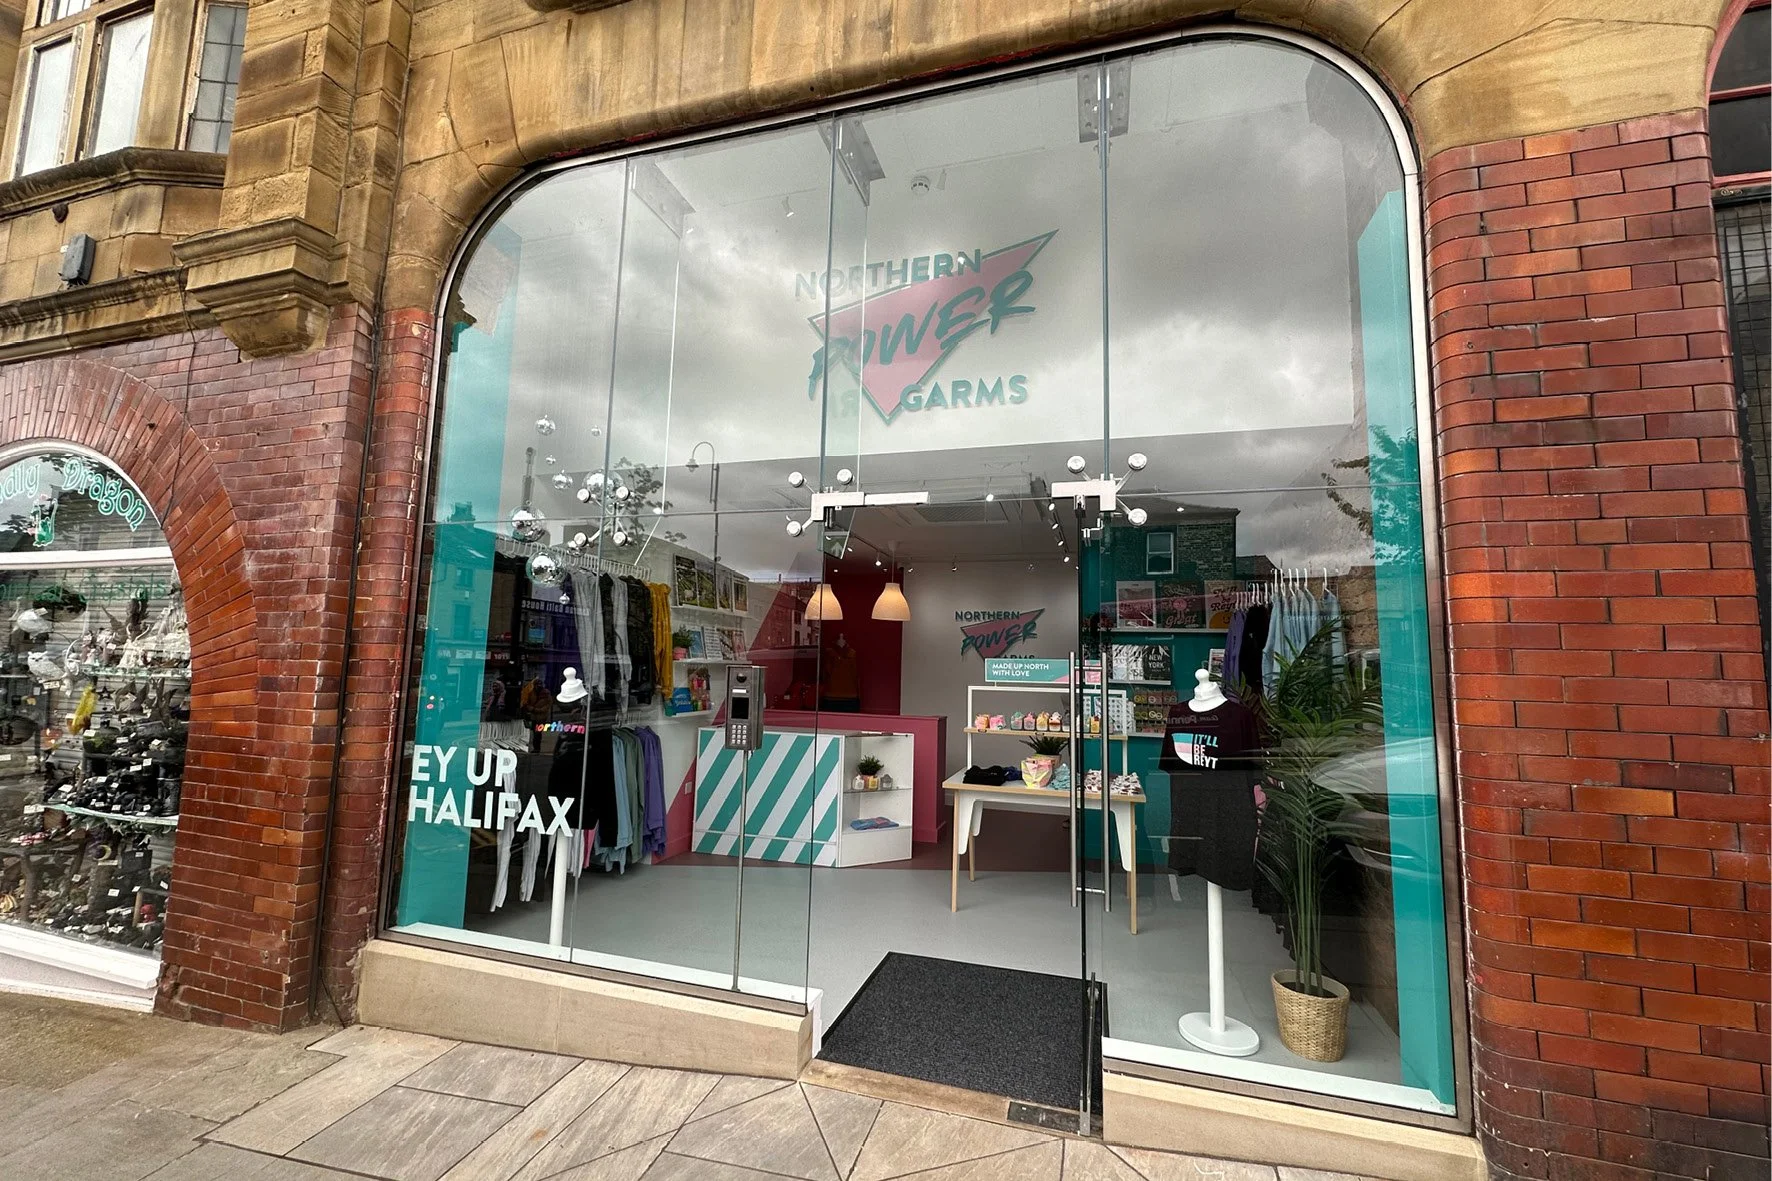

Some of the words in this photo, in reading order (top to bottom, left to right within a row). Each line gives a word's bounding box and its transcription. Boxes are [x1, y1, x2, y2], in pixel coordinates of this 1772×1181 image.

[794, 248, 982, 301] NORTHERN
[808, 270, 1037, 401] POWER
[900, 374, 1029, 413] GARMS
[0, 464, 41, 500] dly
[61, 456, 147, 532] Dragon
[955, 610, 1020, 621] NORTHERN
[961, 620, 1038, 657] POWER
[1148, 661, 1165, 669] YORK
[535, 720, 585, 735] orthern
[1194, 733, 1219, 748] IT'LL
[411, 744, 457, 783] EY
[466, 747, 518, 787] UP
[1193, 744, 1206, 755] BE
[1193, 754, 1219, 769] REYT
[407, 785, 575, 837] HALIFAX
